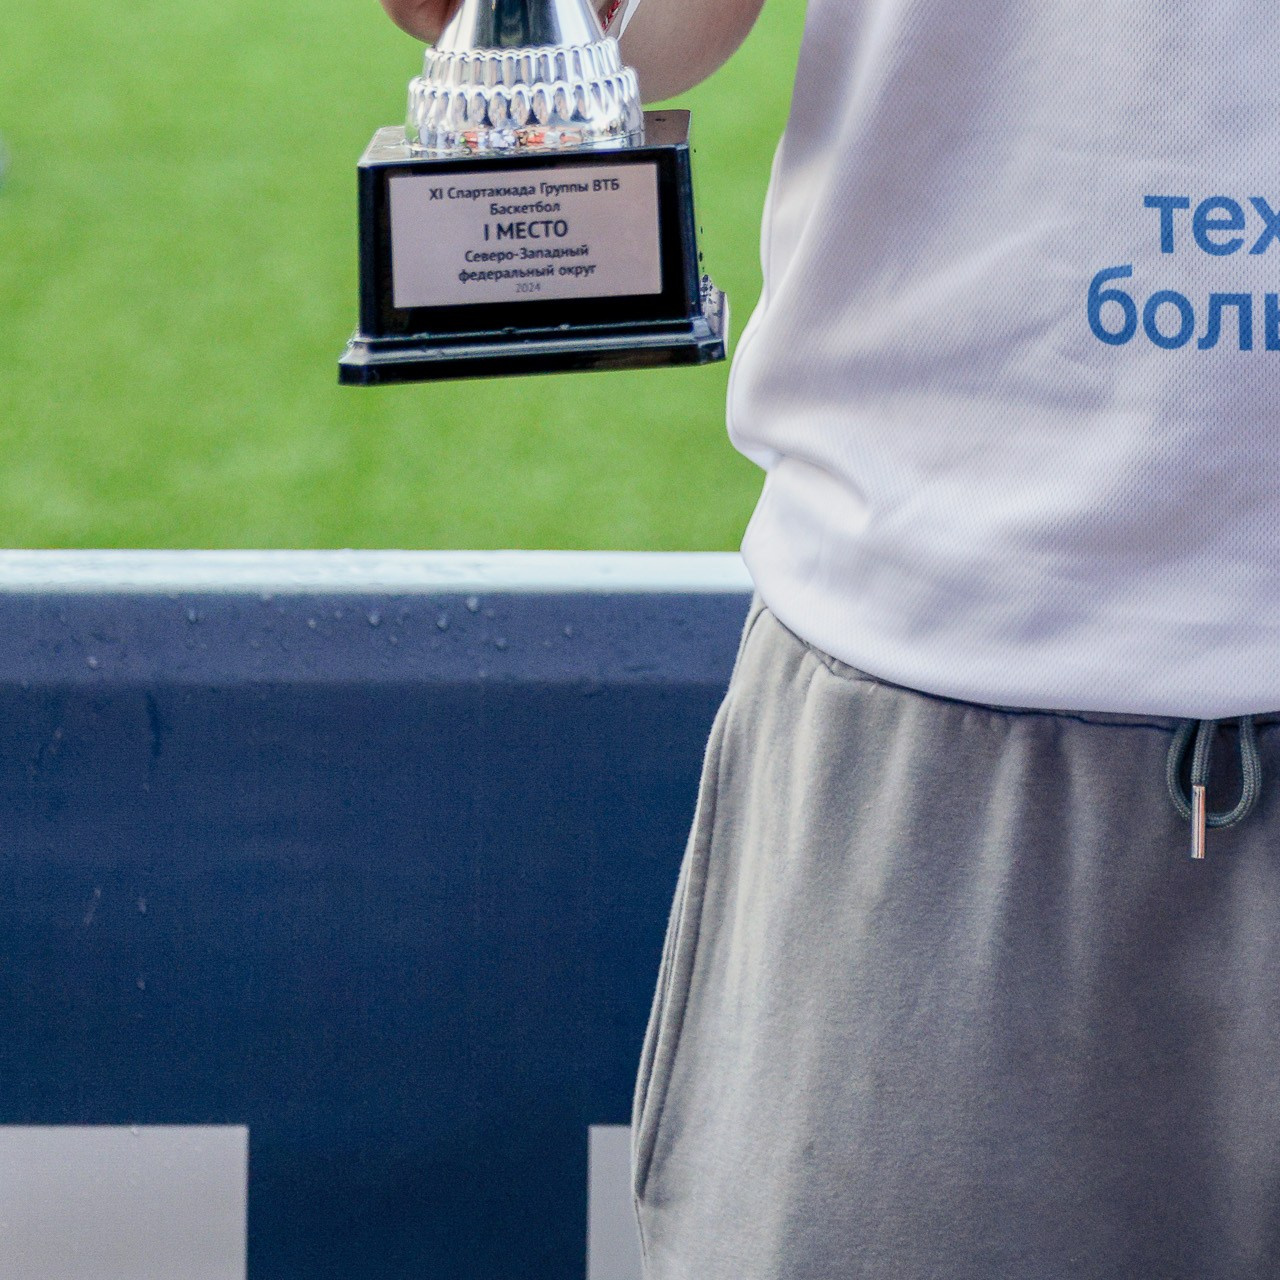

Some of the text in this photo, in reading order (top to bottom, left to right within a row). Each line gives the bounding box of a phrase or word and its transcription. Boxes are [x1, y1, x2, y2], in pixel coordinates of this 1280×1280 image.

[429, 178, 620, 201] XI Спартакиада Группы ВТБ
[490, 201, 561, 215] Баскетбол
[496, 219, 568, 240] МЕСТО
[465, 244, 589, 263] Северо-Западный
[458, 263, 597, 284] федеральный округ
